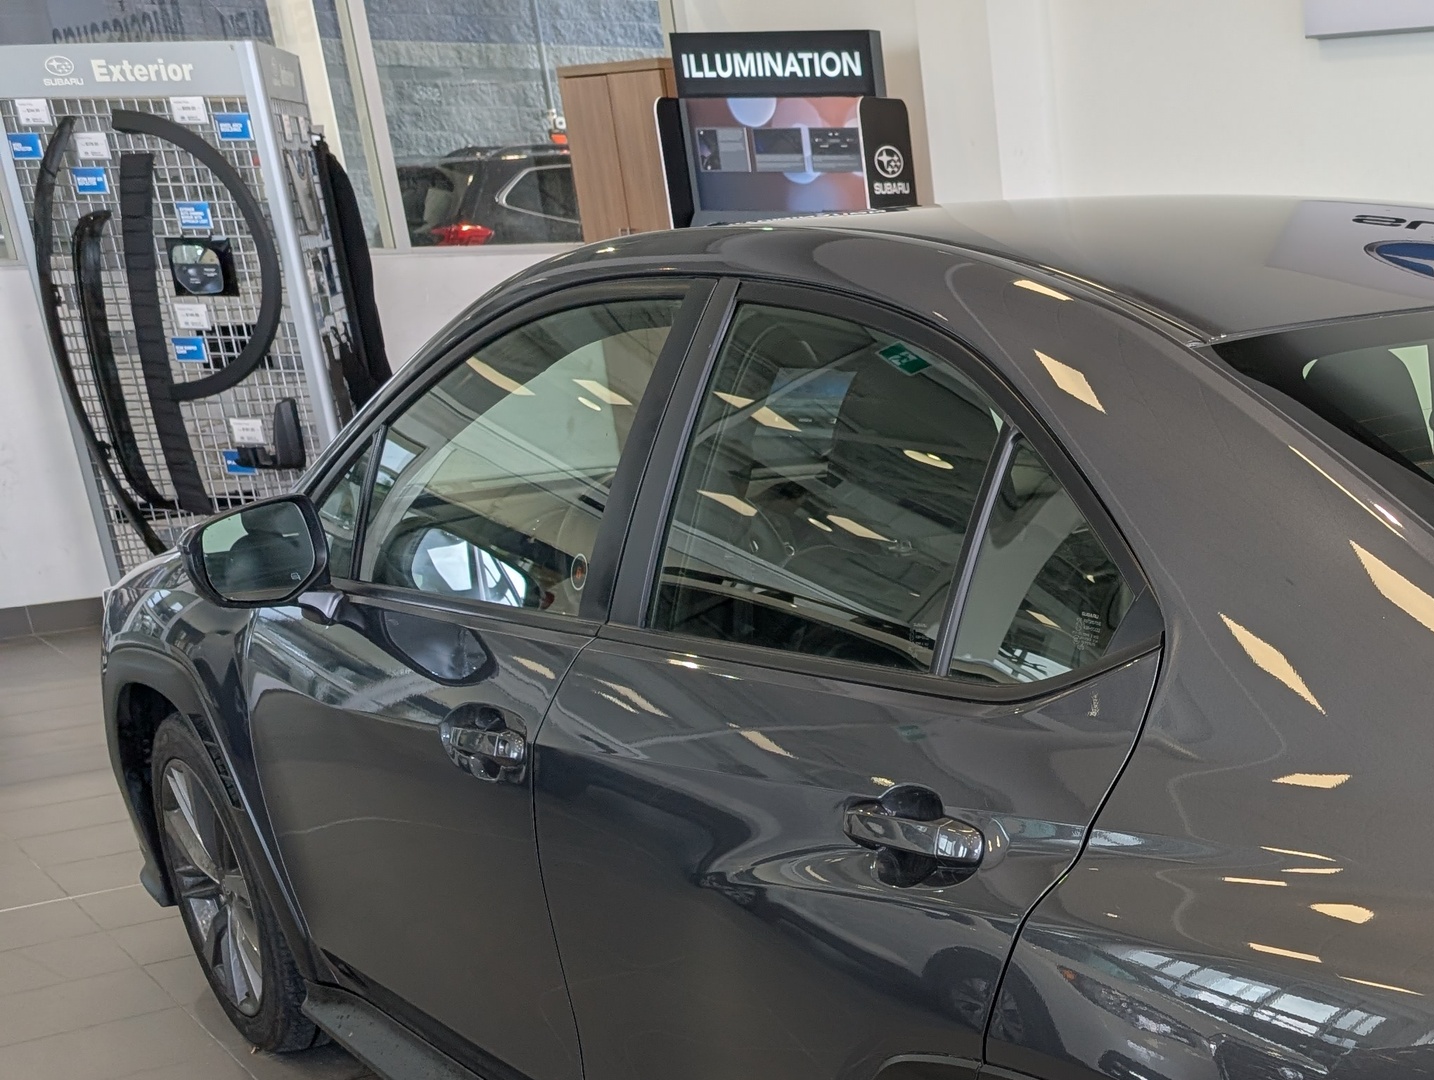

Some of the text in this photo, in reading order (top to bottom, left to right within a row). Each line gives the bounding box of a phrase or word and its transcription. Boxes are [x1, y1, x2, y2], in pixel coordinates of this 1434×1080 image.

[90, 58, 194, 82] Exterior
[681, 51, 863, 78] ILLUMINATION
[43, 78, 85, 86] SUBARU
[873, 182, 910, 195] SUBARU
